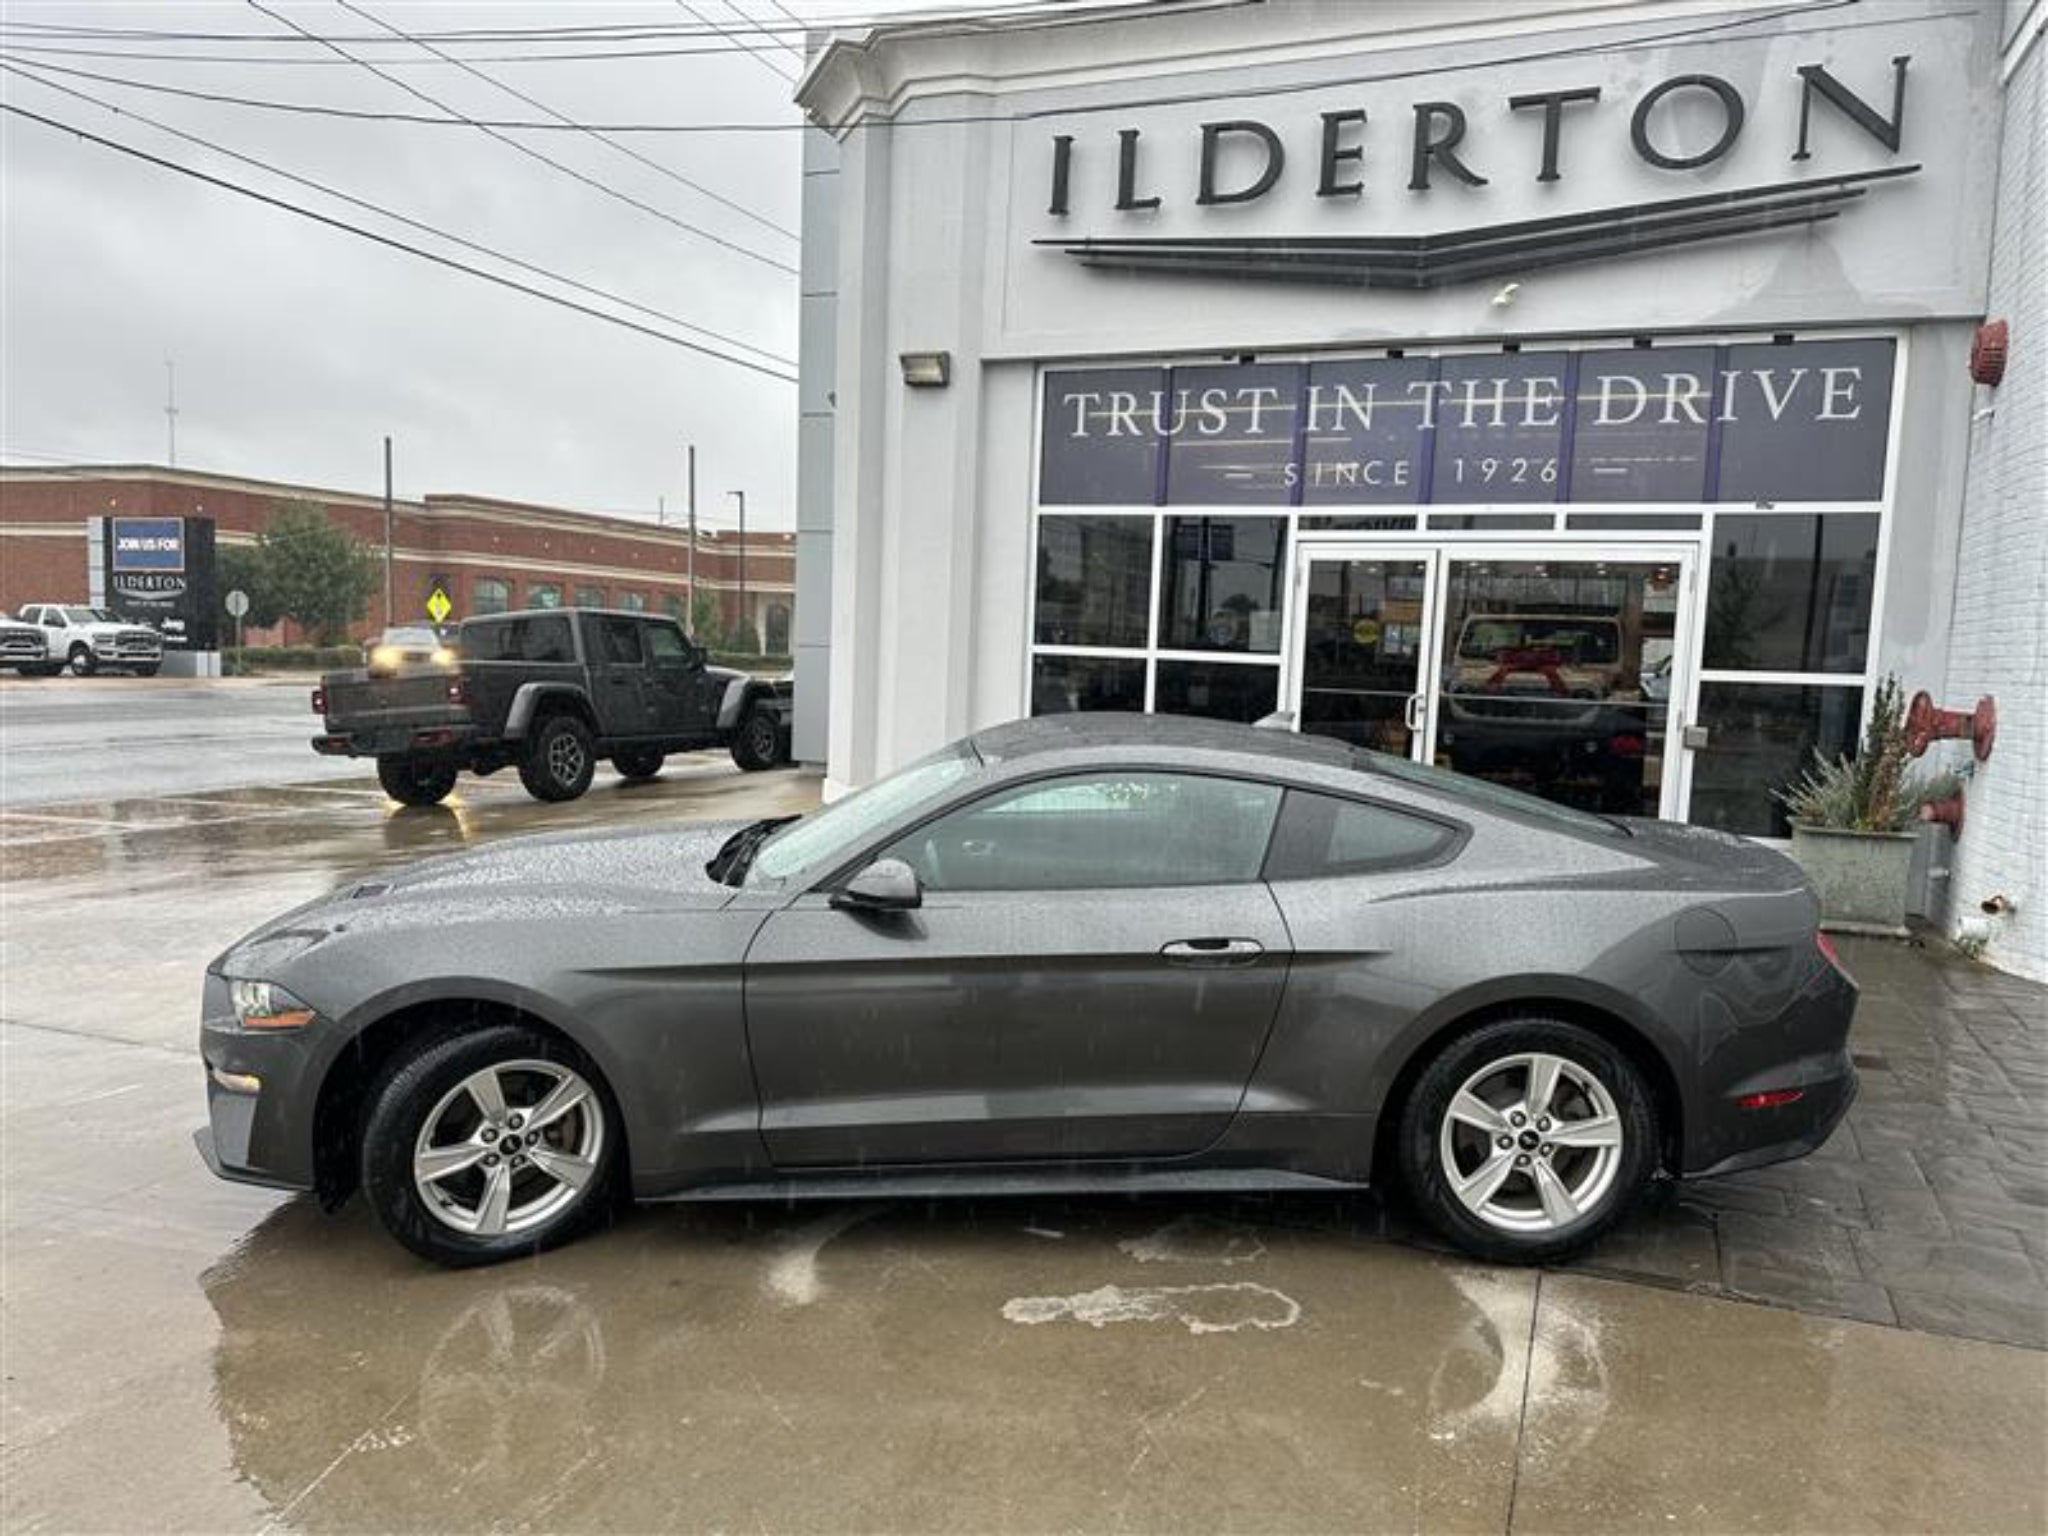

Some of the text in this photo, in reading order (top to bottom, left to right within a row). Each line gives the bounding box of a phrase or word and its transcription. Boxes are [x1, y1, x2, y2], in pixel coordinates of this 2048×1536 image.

[1047, 55, 1911, 216] ILDERTON
[1064, 366, 1863, 437] TRUST IN THE DRIVE
[1283, 457, 1558, 487] SINCE 1926
